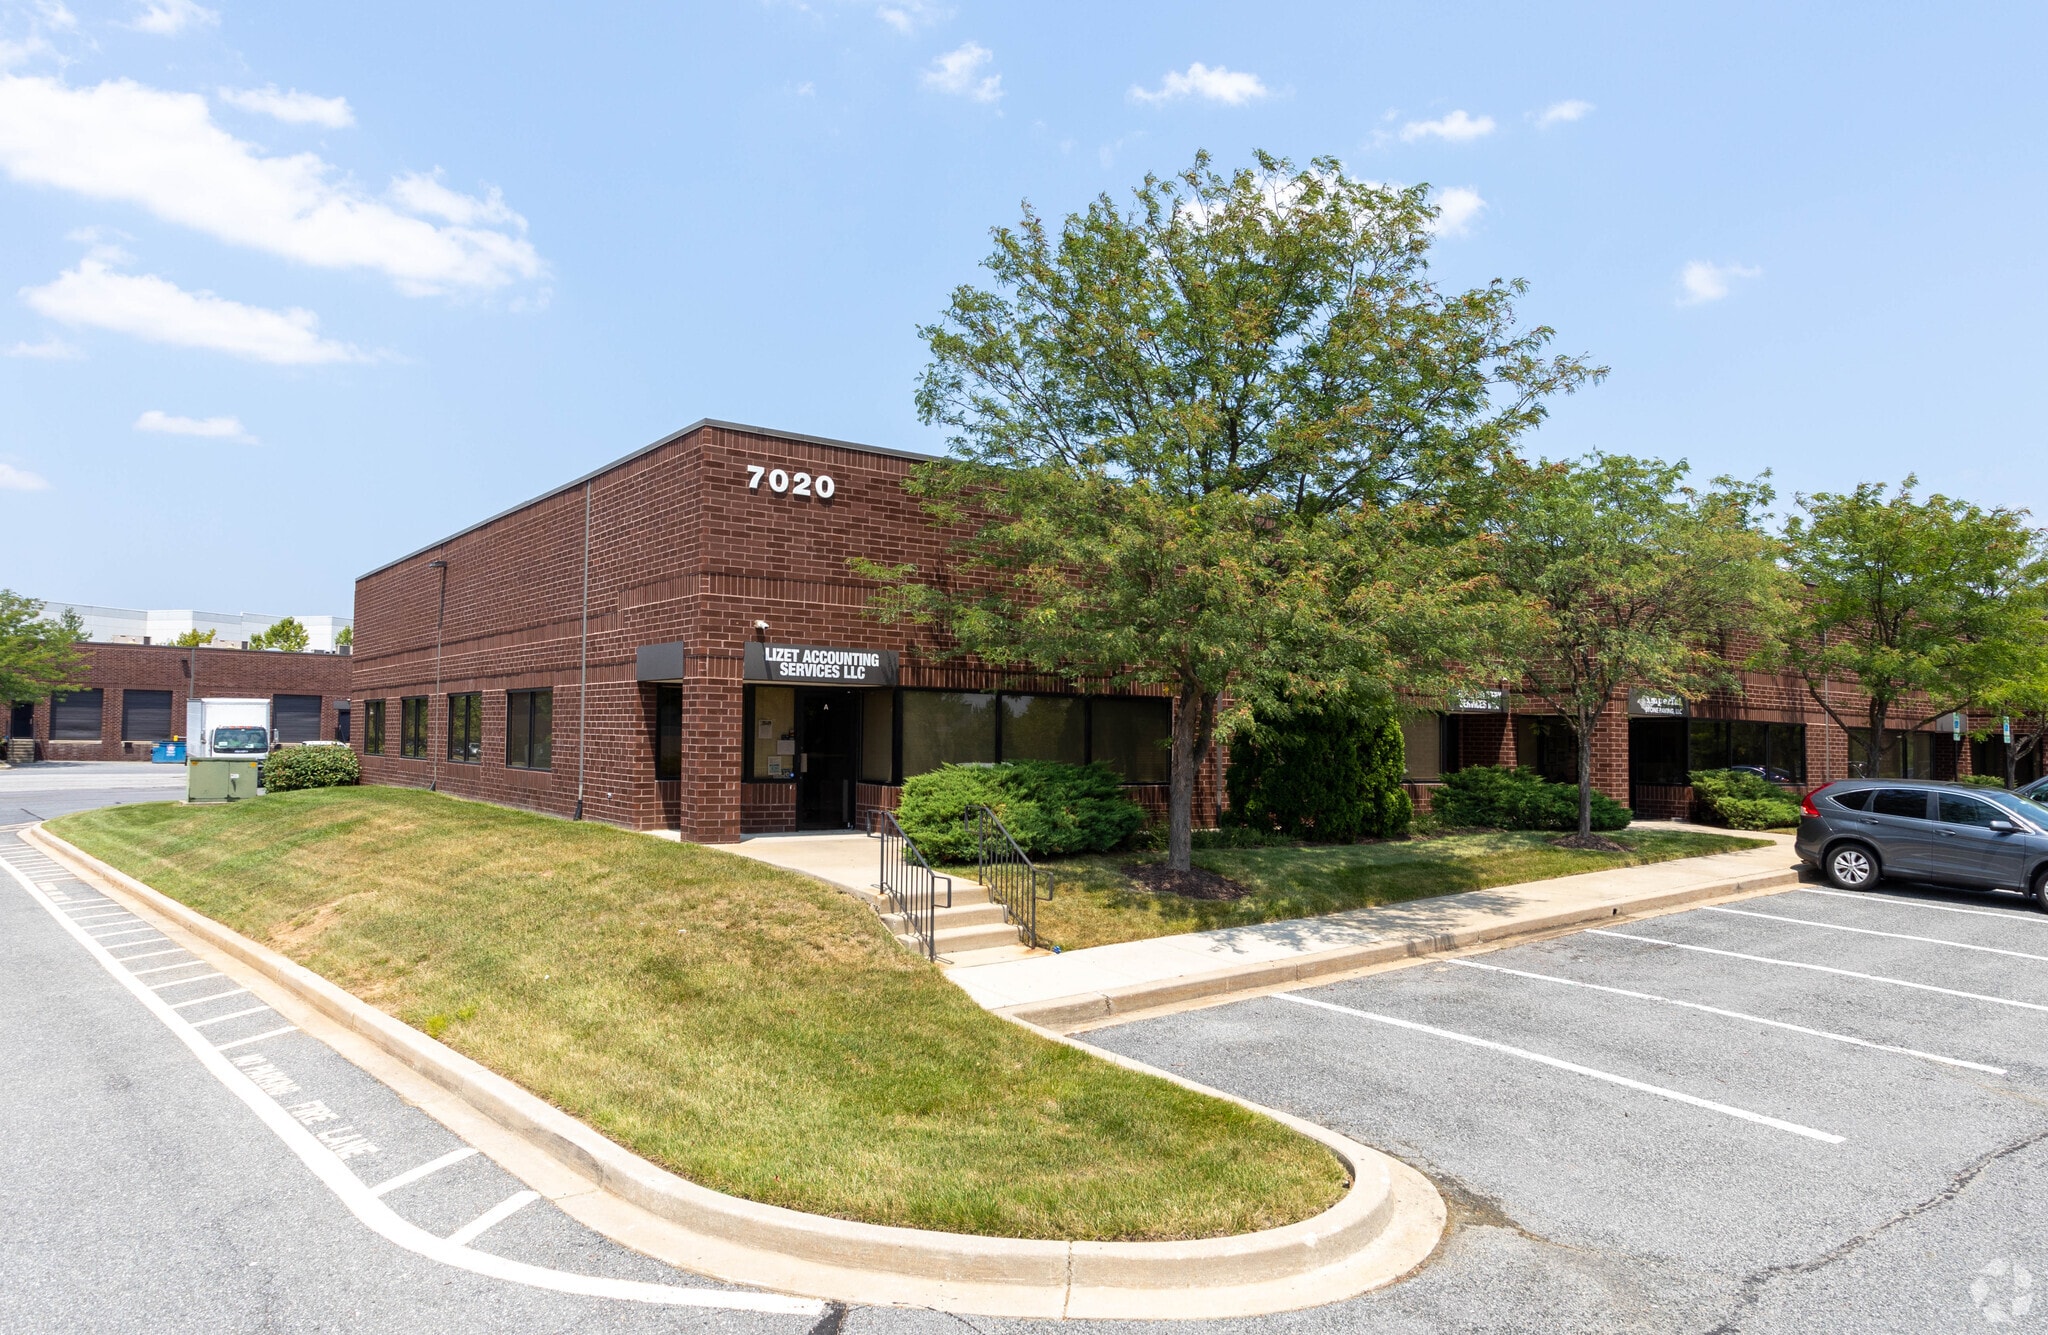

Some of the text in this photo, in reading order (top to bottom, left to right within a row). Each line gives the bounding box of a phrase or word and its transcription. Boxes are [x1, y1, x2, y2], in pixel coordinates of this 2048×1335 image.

[747, 465, 835, 499] 7020
[765, 647, 879, 667] LIZET ACCOUNTING
[780, 662, 866, 680] SERVICES LLC
[823, 703, 829, 711] A
[285, 1099, 341, 1126] FIRE
[315, 1125, 381, 1161] LANE
